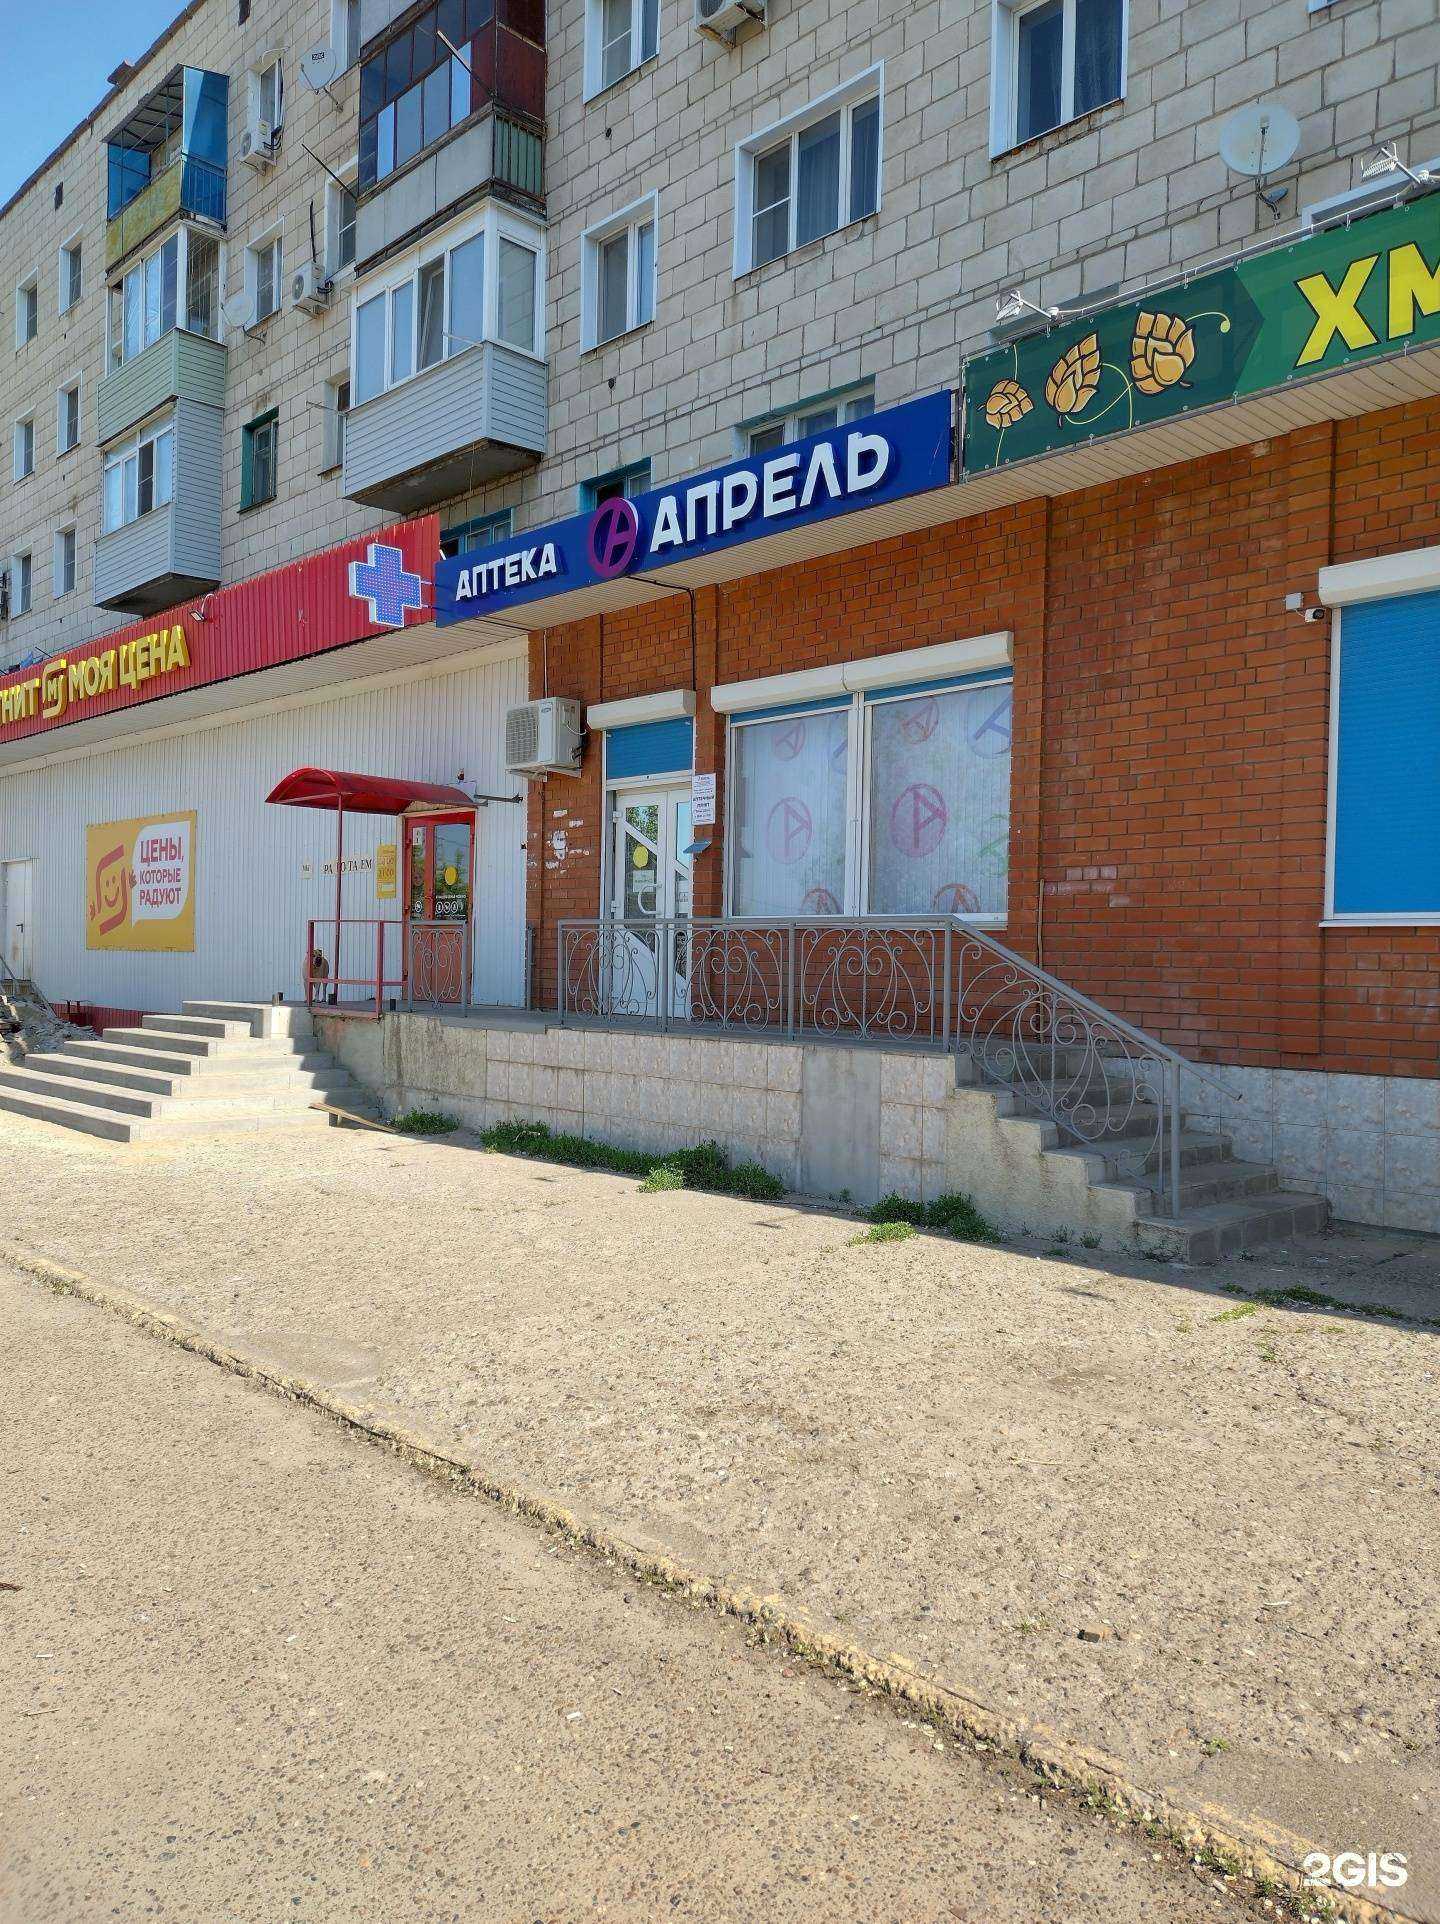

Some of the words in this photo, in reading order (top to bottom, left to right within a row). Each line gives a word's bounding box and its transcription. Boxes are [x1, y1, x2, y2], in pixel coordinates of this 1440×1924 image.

[456, 542, 557, 601] АПТЕКА
[650, 431, 891, 553] АПРЕЛЬ
[0, 678, 41, 724] НИТ
[68, 649, 118, 703] МОЯ
[119, 624, 191, 690] ЦЕНА
[140, 836, 184, 867] ЦЕНЫ,
[139, 867, 181, 885] КОТОРЫЕ
[139, 887, 181, 908] РАДУЮТ
